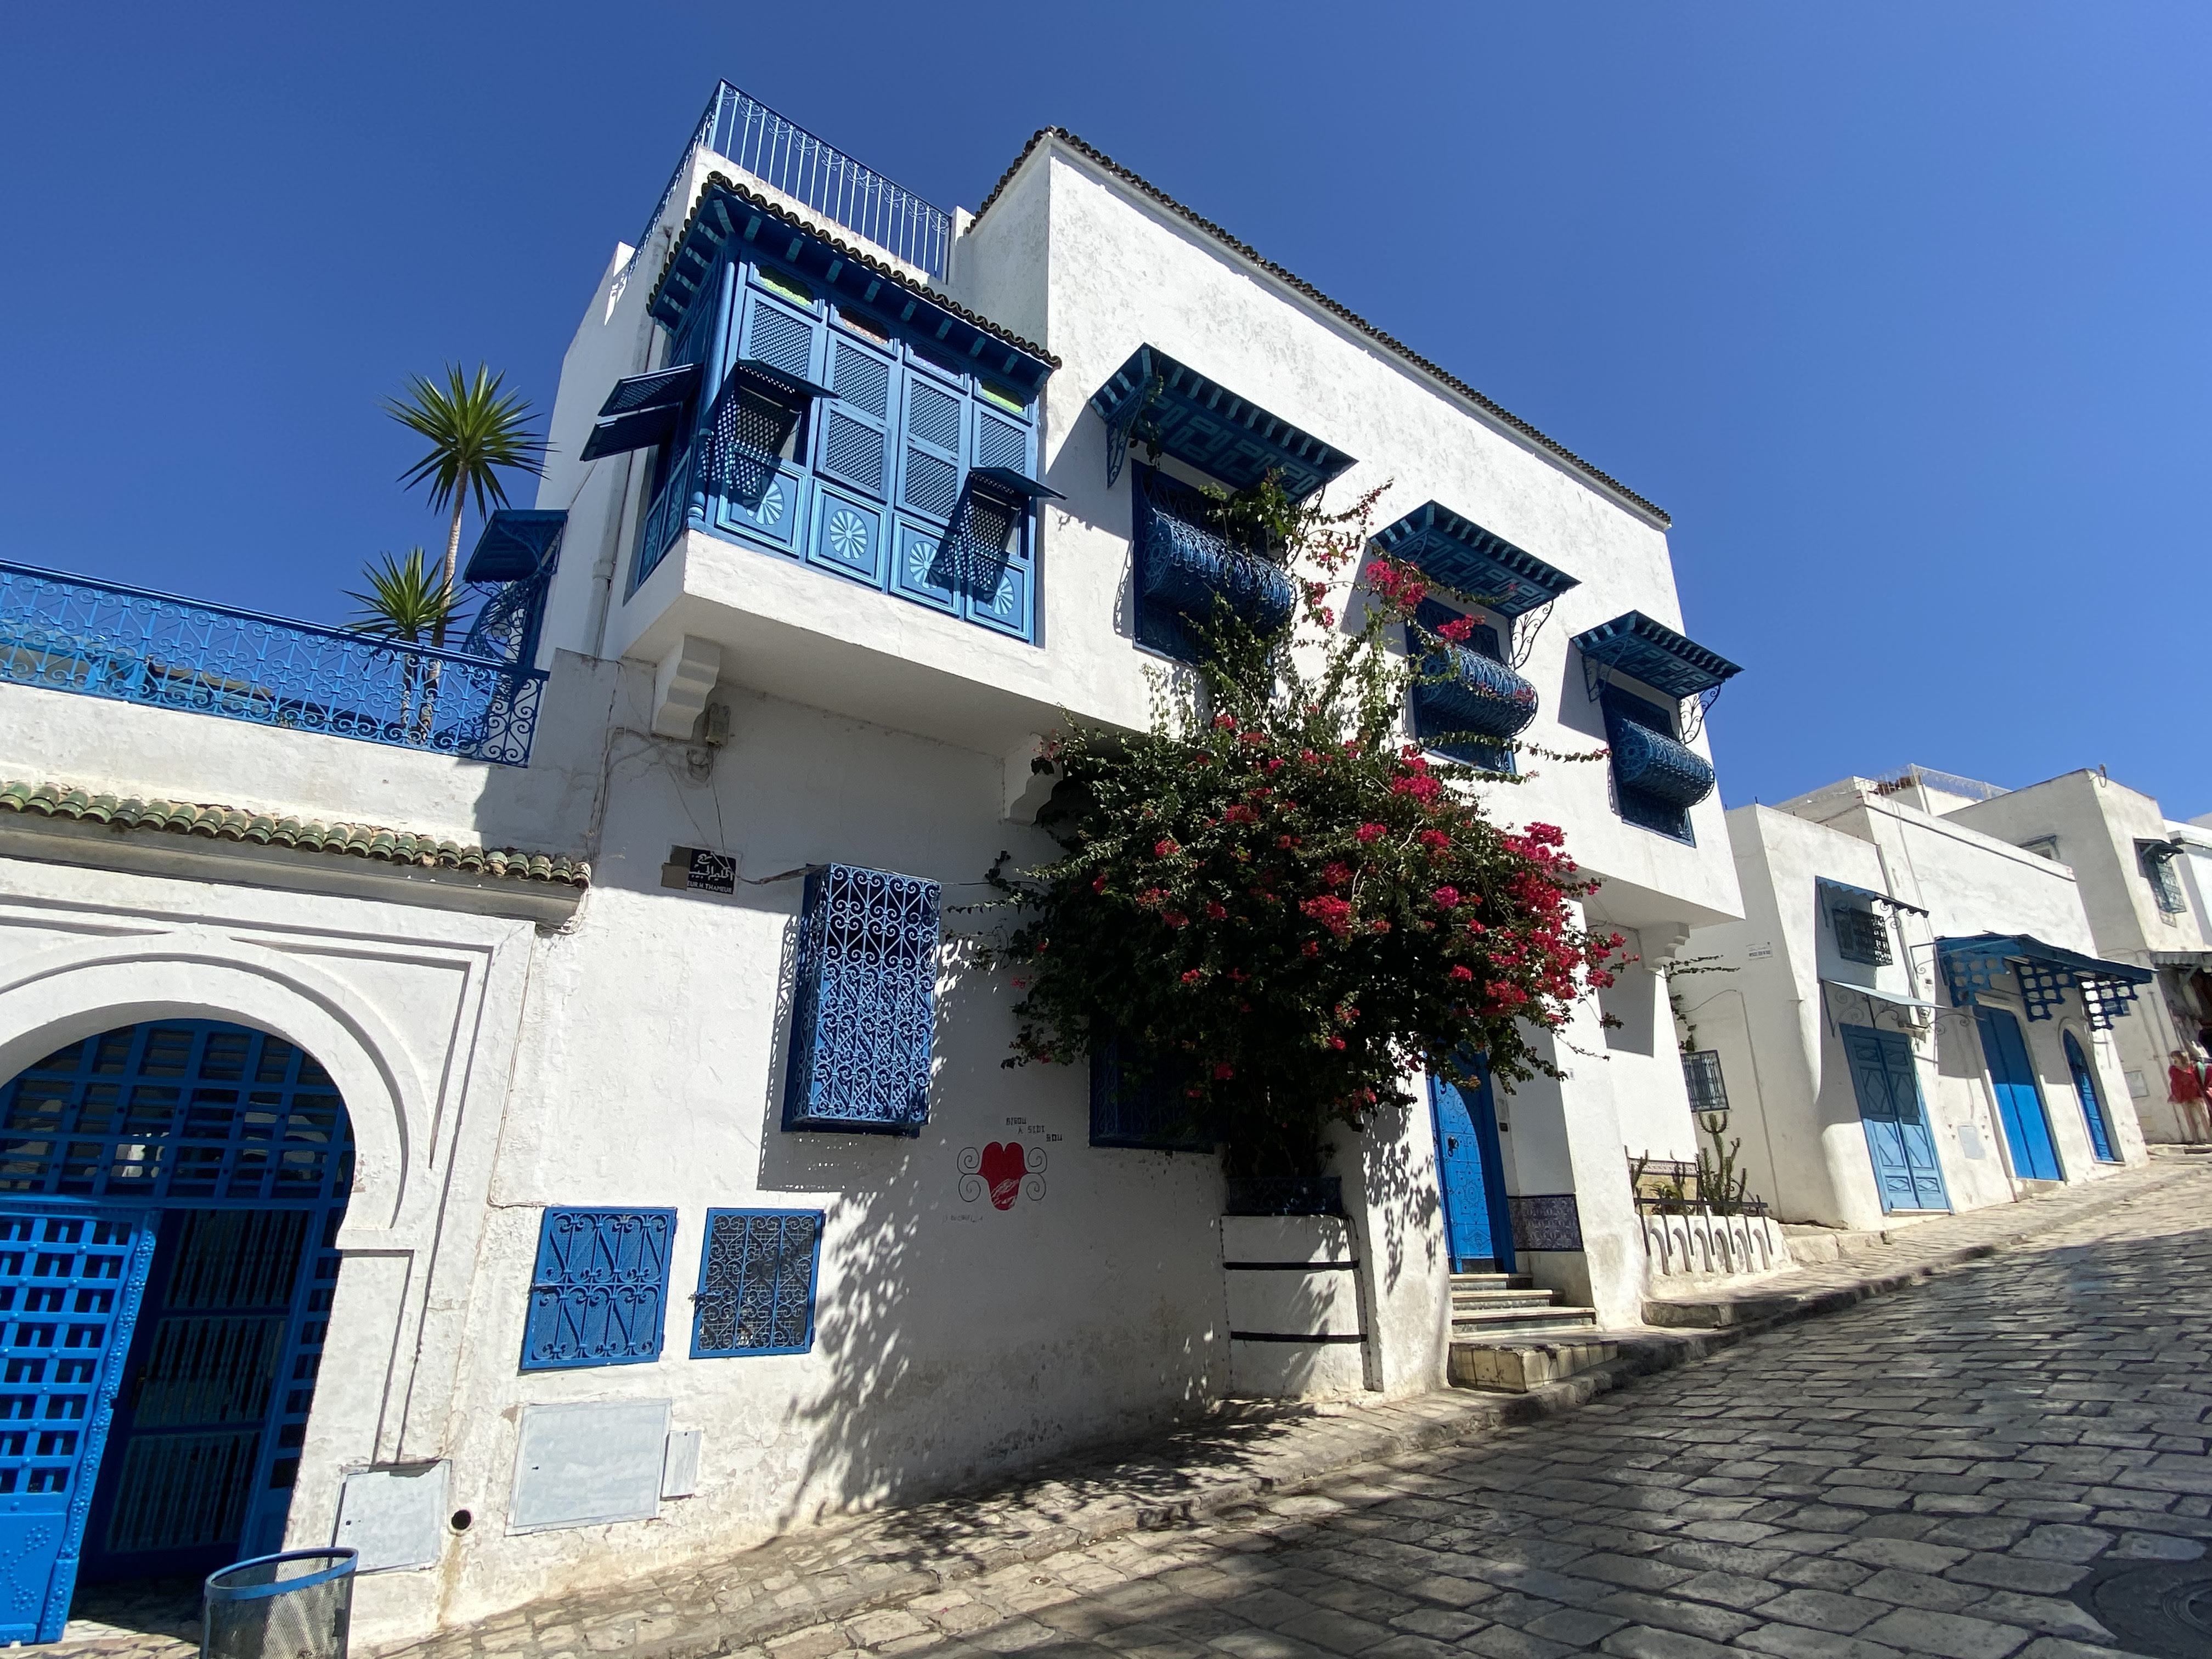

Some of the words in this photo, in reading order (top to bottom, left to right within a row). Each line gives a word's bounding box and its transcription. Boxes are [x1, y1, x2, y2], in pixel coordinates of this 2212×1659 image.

[705, 883, 732, 894] THAMEUR
[1027, 1125, 1045, 1133] SIDI
[1046, 1133, 1063, 1142] BOU
